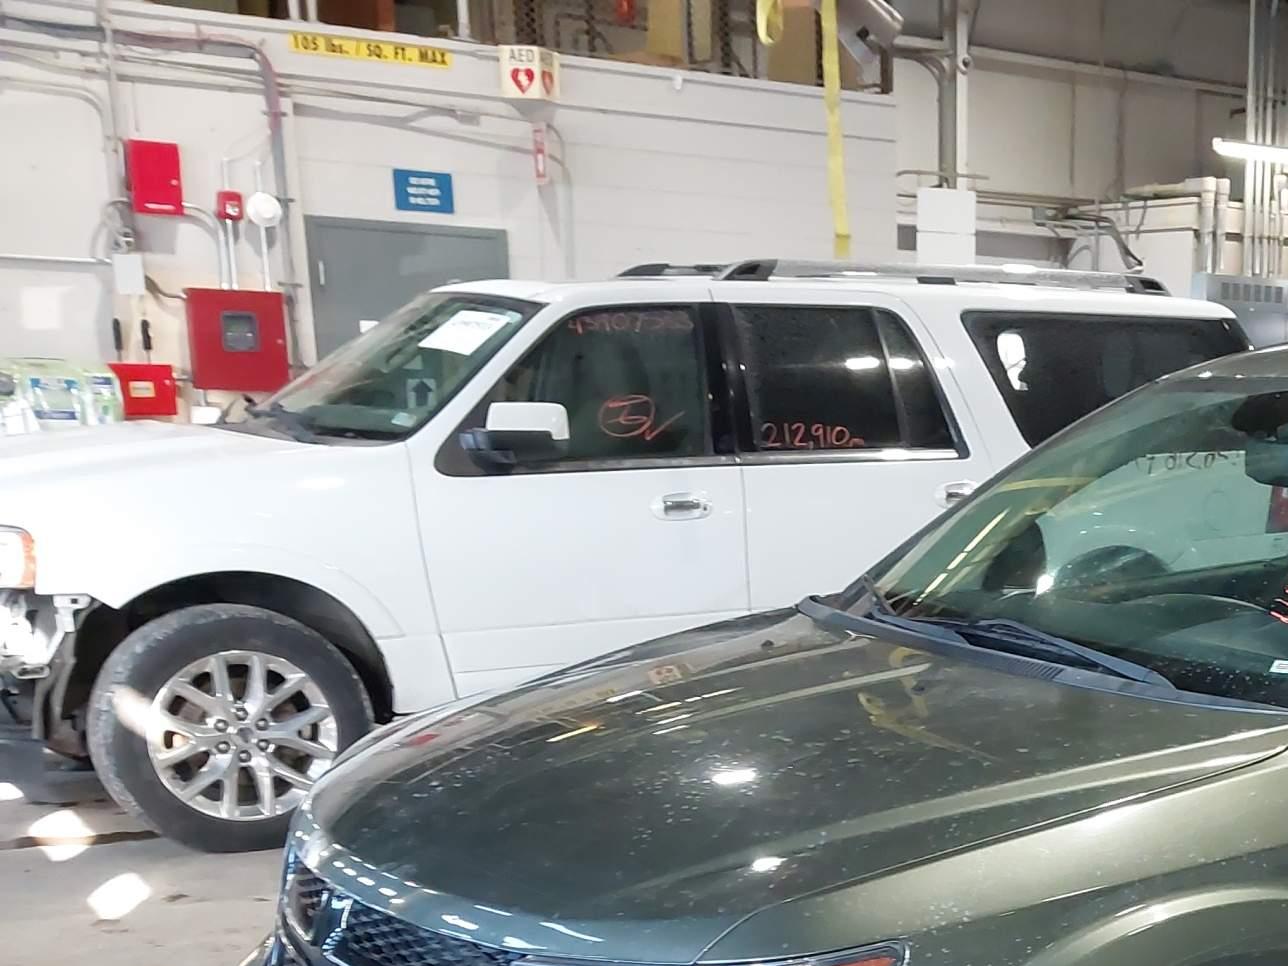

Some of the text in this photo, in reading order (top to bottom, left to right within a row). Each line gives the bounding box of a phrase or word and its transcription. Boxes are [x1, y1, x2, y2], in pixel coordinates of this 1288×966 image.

[292, 32, 319, 51] 105
[418, 47, 448, 66] MAX
[509, 48, 535, 63] AED
